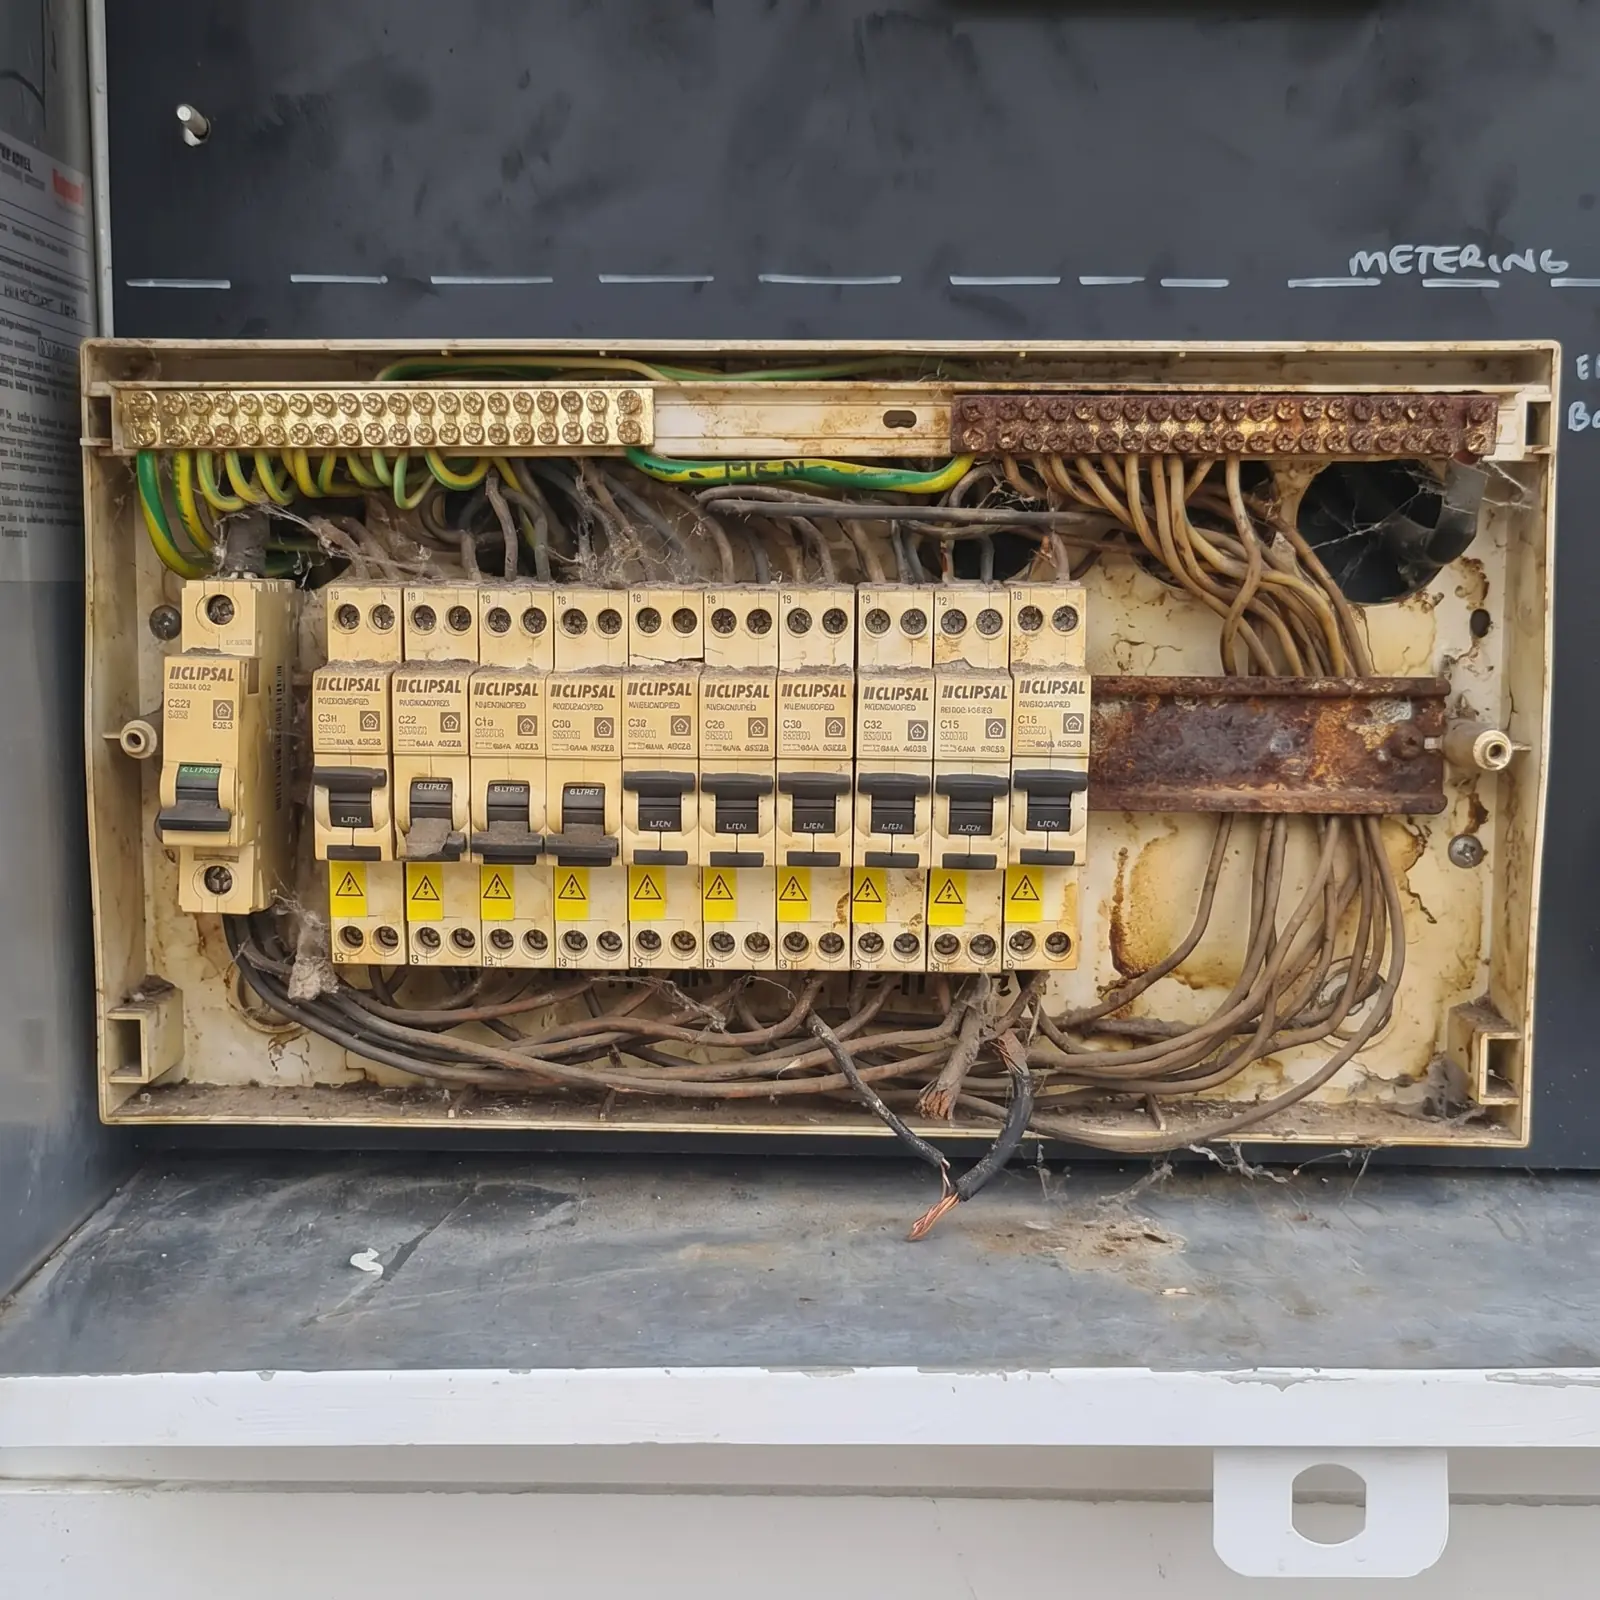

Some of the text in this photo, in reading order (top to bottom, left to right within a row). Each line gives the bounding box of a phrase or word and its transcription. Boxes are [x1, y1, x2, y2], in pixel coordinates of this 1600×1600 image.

[1349, 244, 1569, 276] METERING
[725, 460, 805, 479] MEN
[182, 667, 234, 681] CLIPSAL
[329, 678, 380, 691] CLIPSAL
[409, 680, 461, 693] CLIPSAL
[486, 683, 539, 696] CLIPSAL
[639, 683, 692, 696] CLIPSAL
[794, 684, 846, 698] CLIPSAL
[1032, 680, 1085, 694] CLIPSAL
[562, 685, 615, 698] CLIPSAL
[716, 685, 769, 698] CLIPSAL
[876, 687, 928, 701] CLIPSAL
[954, 685, 1007, 699] CLIPSAL
[940, 720, 959, 729] C15
